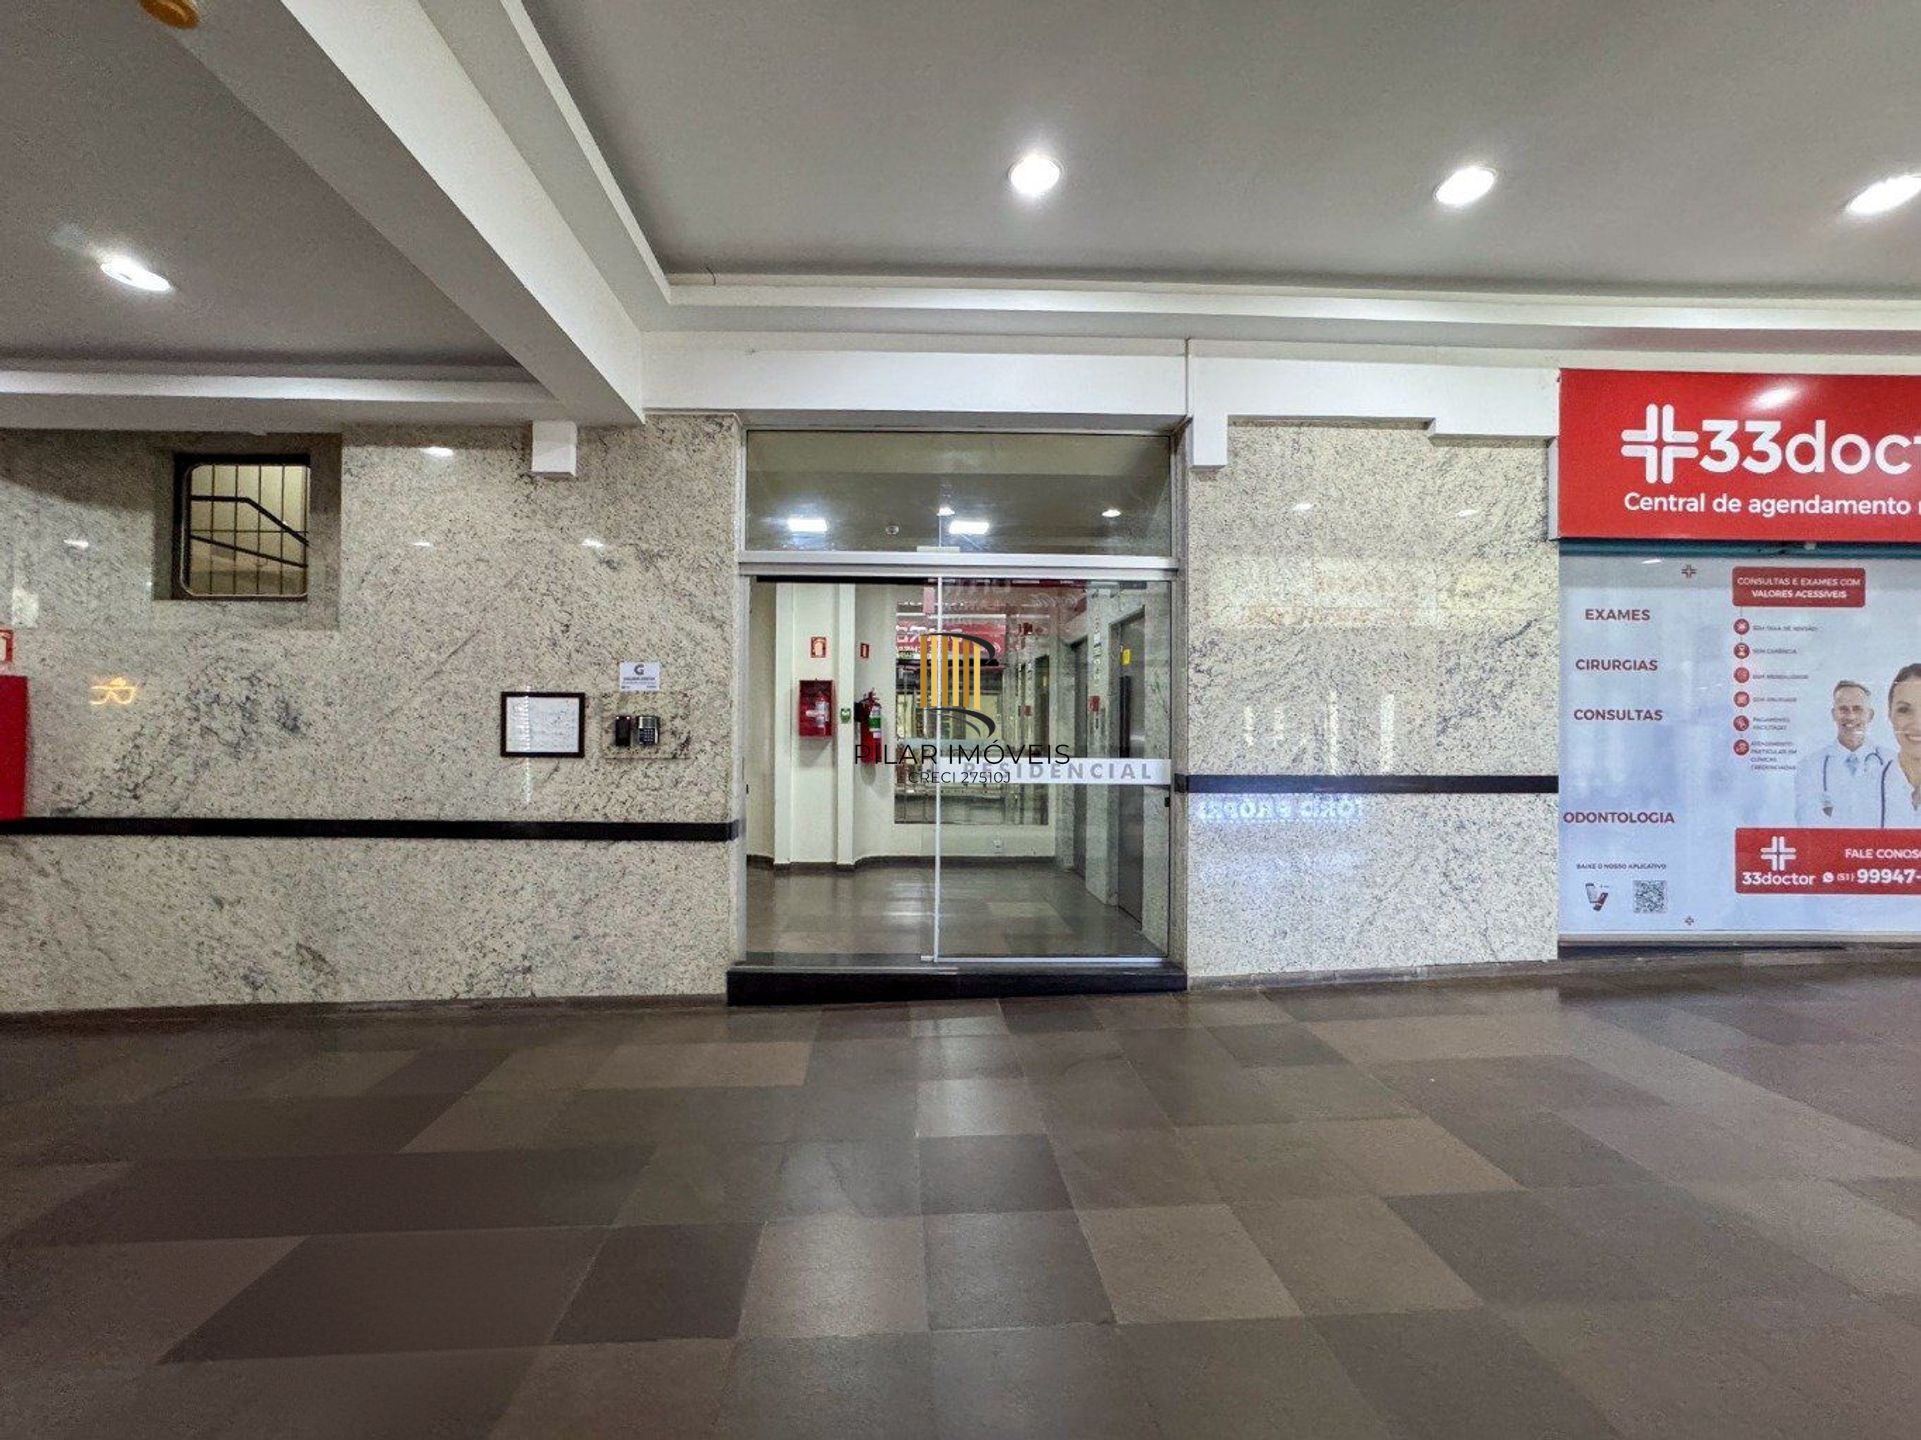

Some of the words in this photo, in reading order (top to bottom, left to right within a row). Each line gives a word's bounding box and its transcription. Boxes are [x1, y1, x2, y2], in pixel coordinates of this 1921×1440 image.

[1699, 420, 1921, 474] 33doc
[1624, 492, 1705, 513] Central
[1712, 493, 1742, 513] de
[1749, 495, 1910, 518] agendamento
[1737, 577, 1790, 586] CONSULTAS
[1792, 578, 1799, 586] E
[1800, 578, 1838, 587] EXAMES
[1839, 578, 1861, 586] COM
[1752, 590, 1793, 599] VALORES
[1585, 609, 1651, 621] EXAMES
[1575, 659, 1658, 671] CIRURGIAS
[1573, 709, 1663, 721] CONSULTAS
[963, 762, 1153, 780] RESIDENCIAL
[1563, 812, 1675, 824] ODONTOLOGIA
[1845, 848, 1873, 859] FALE
[1876, 848, 1921, 860] CONOS
[1742, 872, 1816, 886] 33doctor
